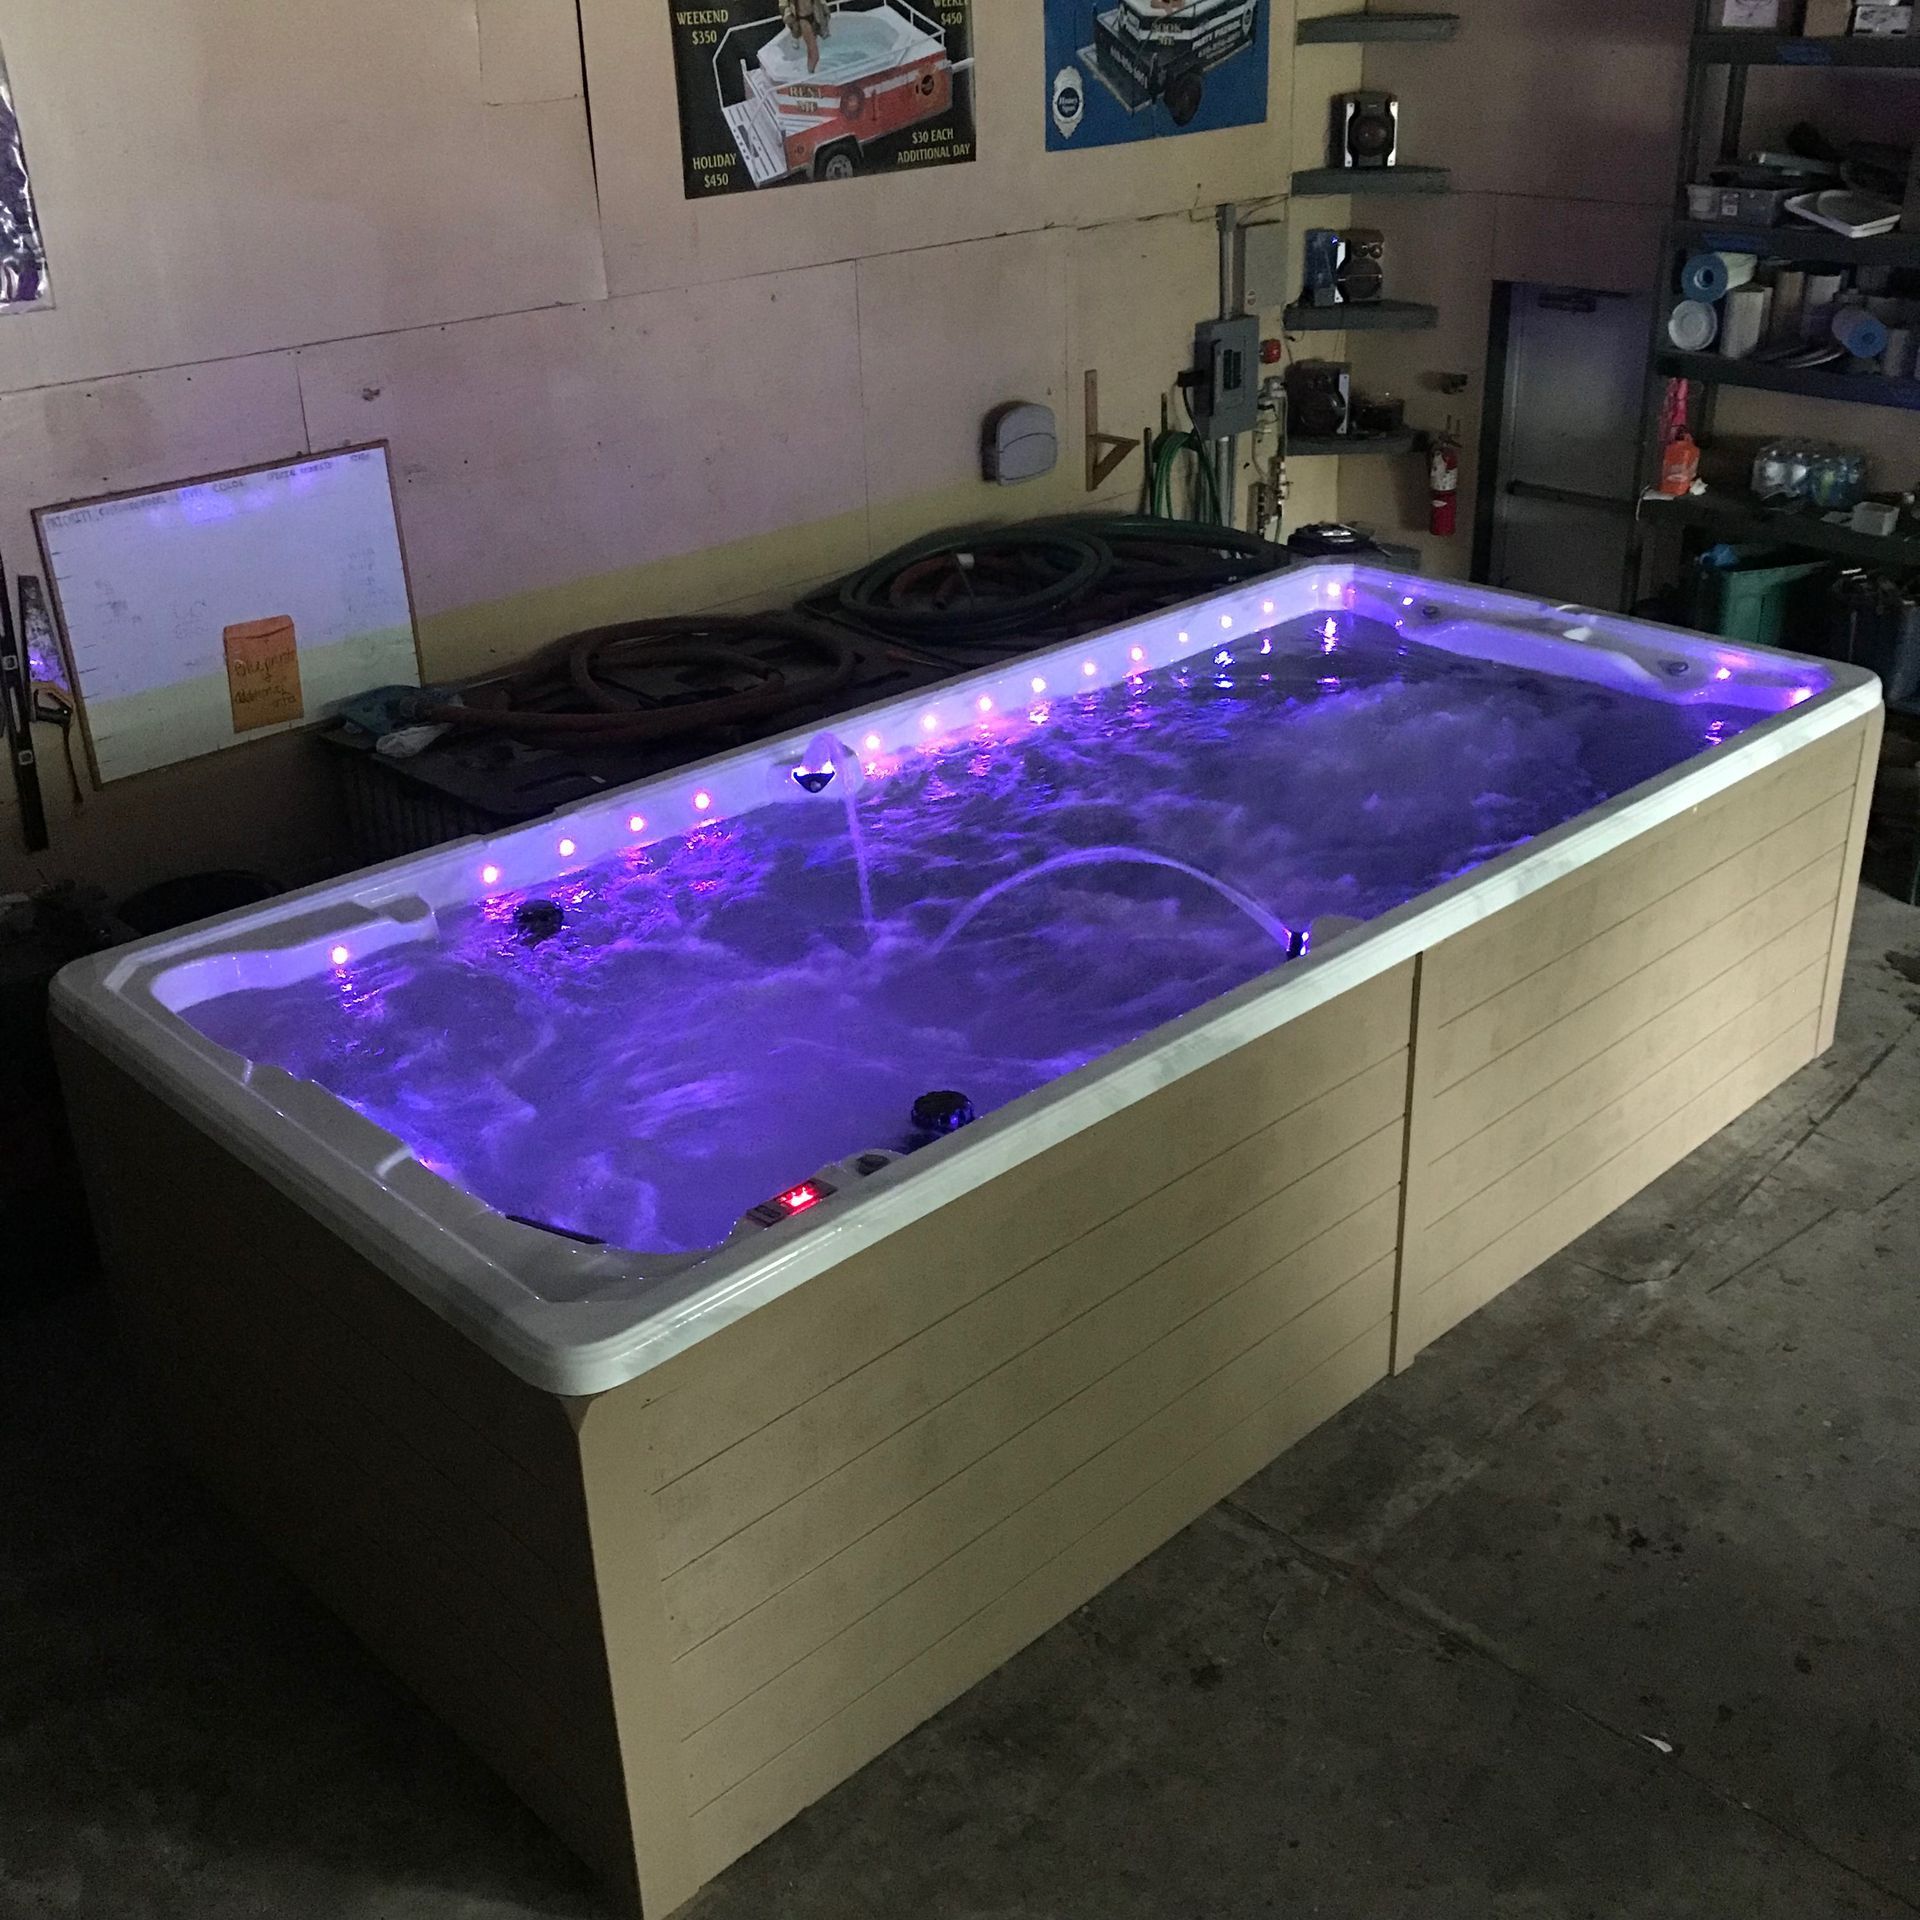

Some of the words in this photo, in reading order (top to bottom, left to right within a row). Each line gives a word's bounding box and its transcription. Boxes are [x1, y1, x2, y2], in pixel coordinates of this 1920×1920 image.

[676, 9, 729, 25] WEEKEND
[940, 11, 962, 25] $450
[692, 30, 717, 45] $350
[912, 131, 929, 145] $30
[931, 127, 954, 142] EACH
[692, 152, 737, 170] HOLIDAY
[897, 146, 951, 163] ADDITIONAL
[953, 143, 971, 157] DAY
[704, 172, 729, 188] $450
